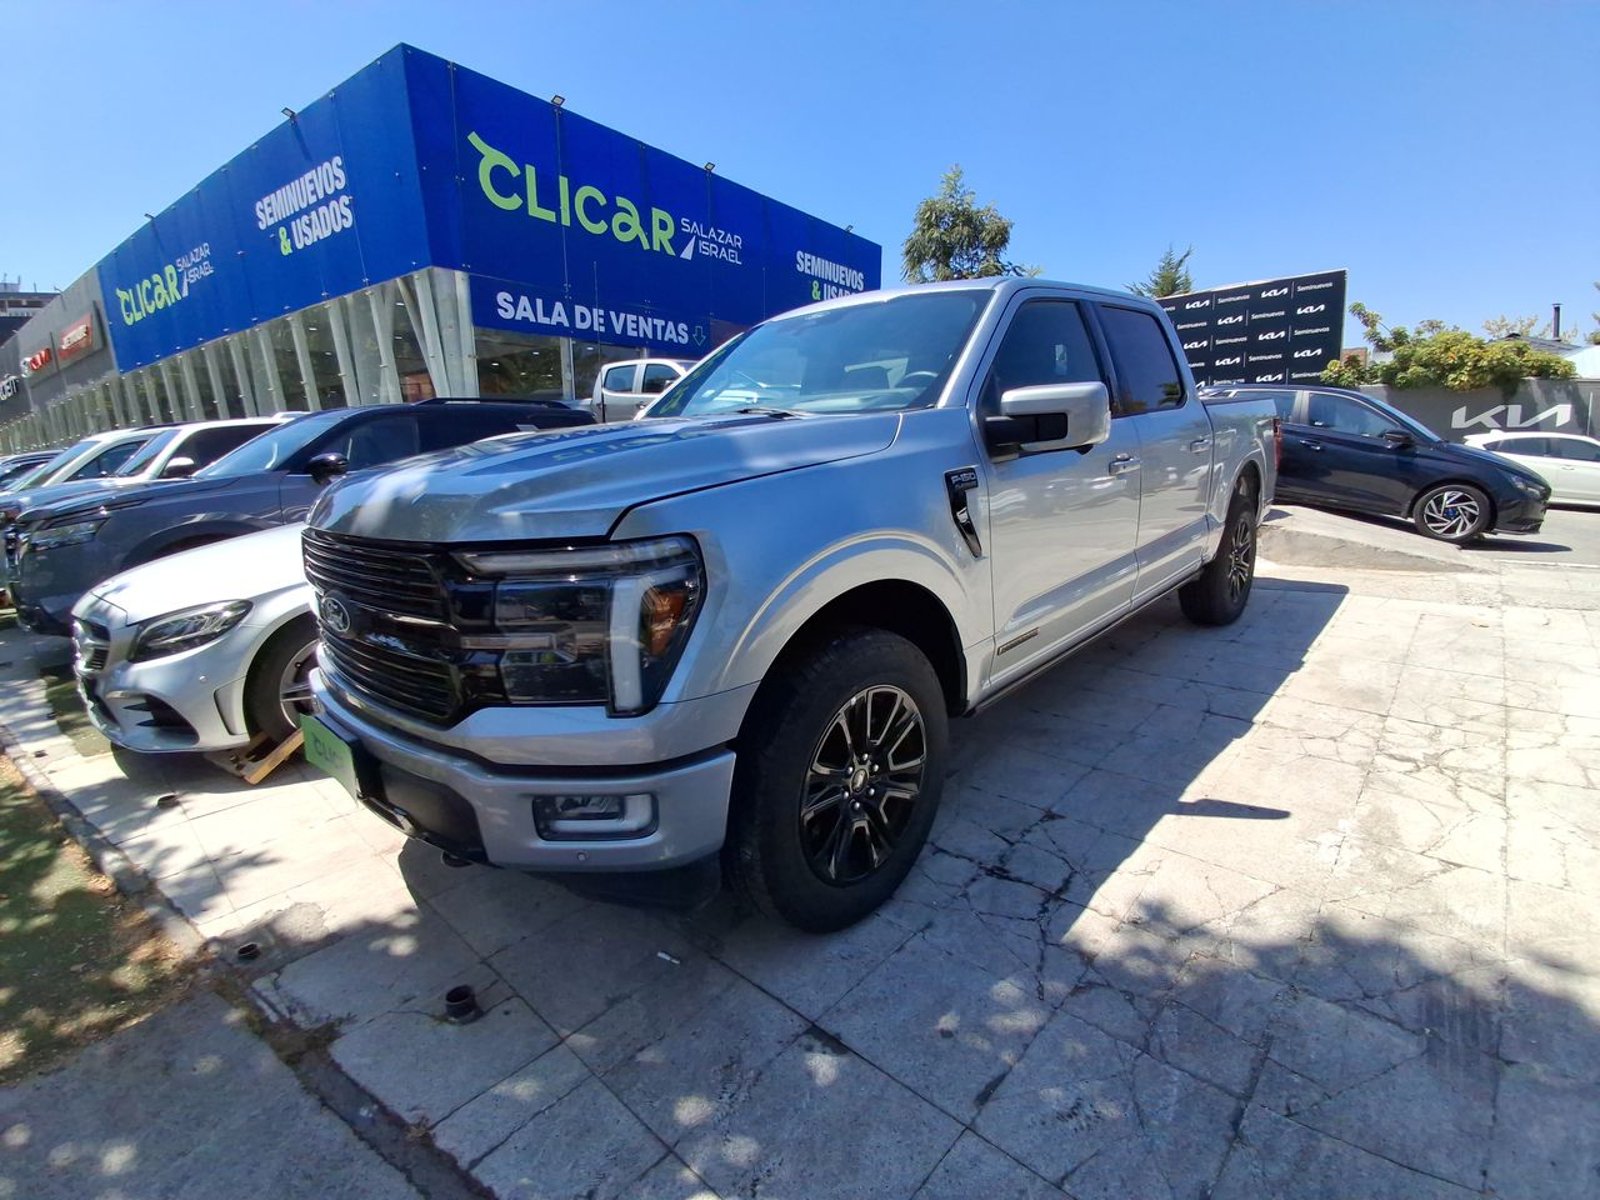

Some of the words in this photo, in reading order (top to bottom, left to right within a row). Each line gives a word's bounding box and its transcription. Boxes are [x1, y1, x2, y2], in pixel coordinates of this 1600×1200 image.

[255, 156, 346, 230] SEMINUEVOS
[278, 226, 293, 256] &
[291, 195, 353, 250] USADOS
[681, 217, 742, 249] SALAZAR
[175, 242, 211, 272] SALAZAR
[699, 239, 742, 265] ISRAEL
[796, 250, 864, 291] SEMINUEVOS
[811, 280, 821, 300] &
[1297, 282, 1333, 292] Seminuevos
[496, 291, 570, 327] SALA
[574, 305, 605, 332] DE
[609, 311, 689, 344] VENTAS
[1294, 326, 1329, 336] Seminuevos
[1451, 404, 1572, 429] KIA
[951, 472, 976, 485] F-150
